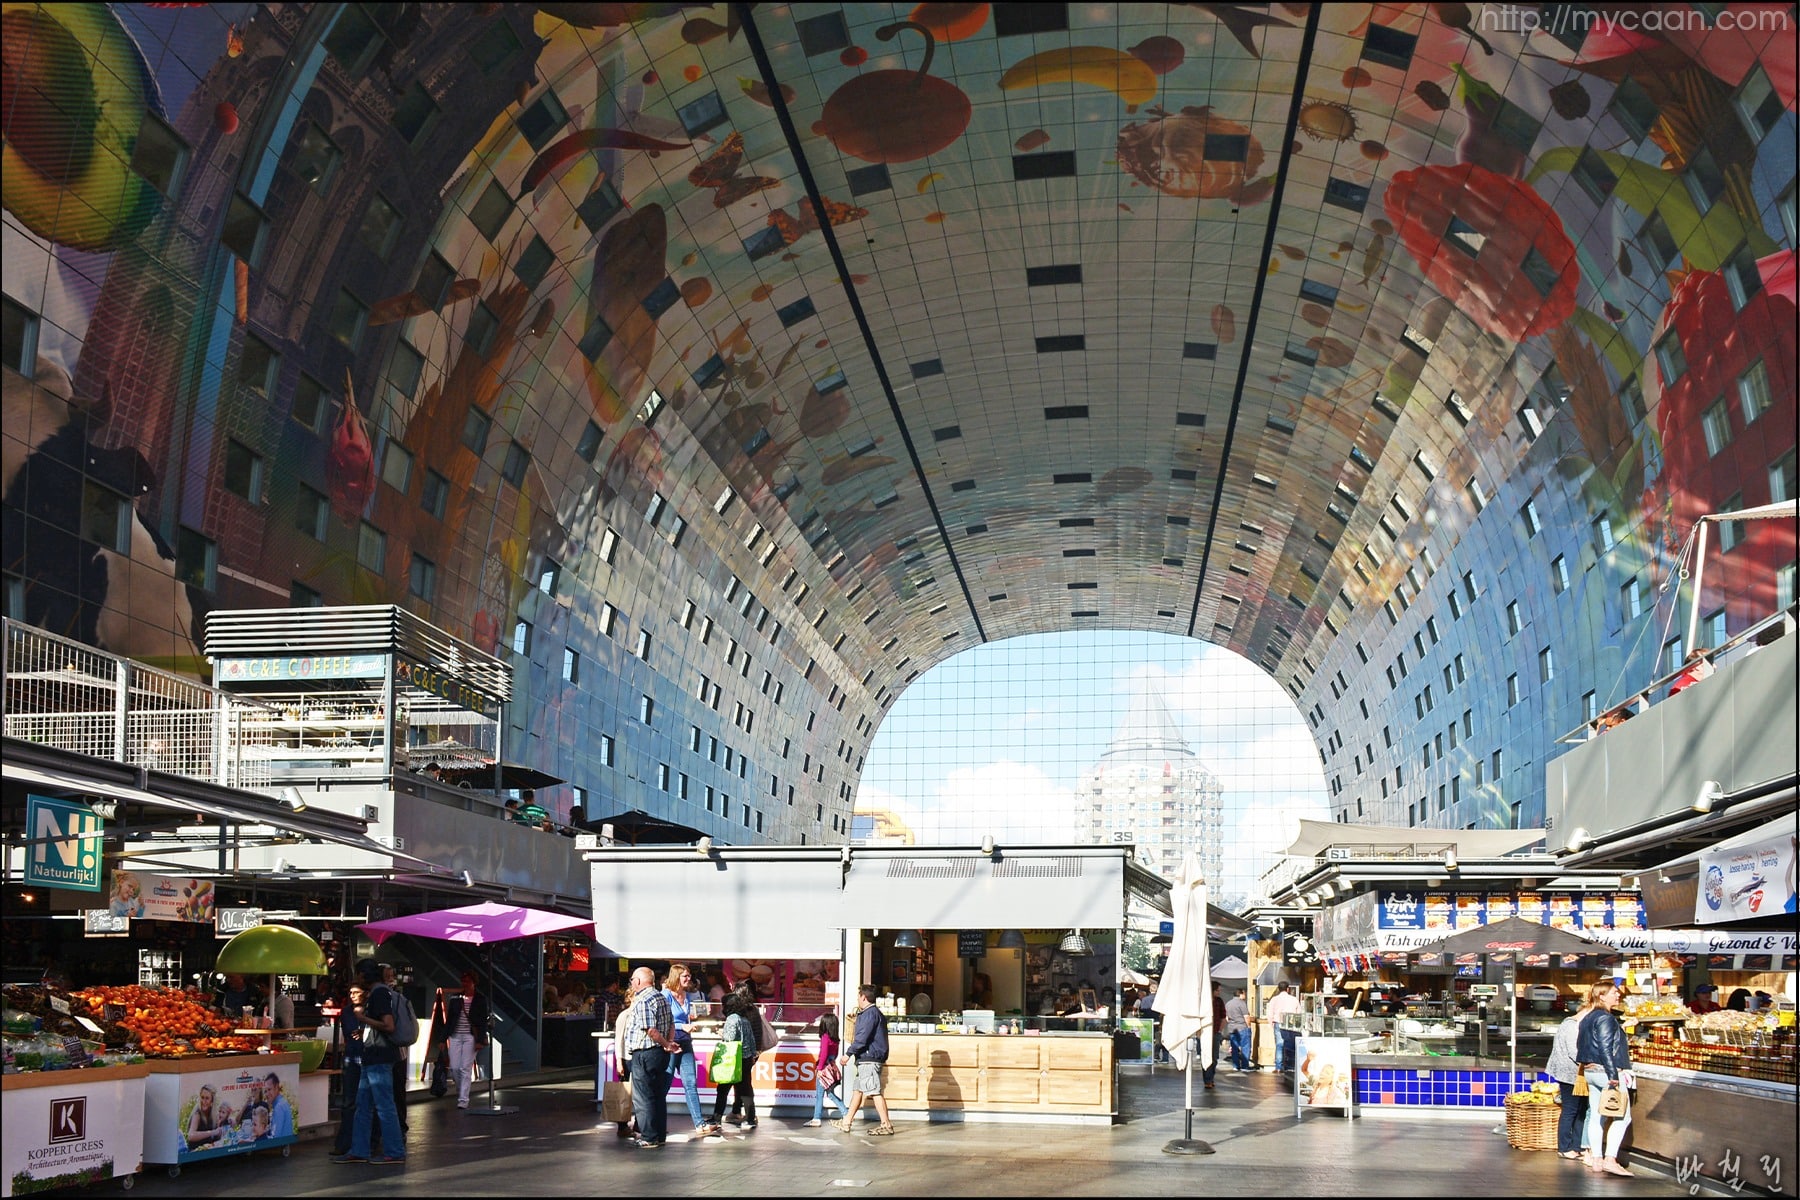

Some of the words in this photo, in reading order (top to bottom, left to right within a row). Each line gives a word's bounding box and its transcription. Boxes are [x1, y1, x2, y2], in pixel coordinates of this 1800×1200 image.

[249, 659, 281, 678] C&E
[288, 656, 352, 677] COFFEE
[413, 667, 437, 692] C&E
[441, 679, 484, 713] COFFEE
[369, 807, 375, 818] 3
[35, 807, 95, 869] N!
[577, 837, 595, 846] 37
[1114, 832, 1133, 841] 39
[1761, 857, 1778, 868] herring
[34, 865, 94, 883] Natuurlijk!
[1384, 933, 1411, 947] Fish
[1620, 935, 1648, 949] Olie
[1709, 936, 1762, 952] Gezond
[1763, 936, 1776, 949] &
[755, 1061, 815, 1082] RESS
[28, 1144, 74, 1161] KOPPERT
[74, 1140, 104, 1153] CRESS
[27, 1158, 68, 1171] Architecture
